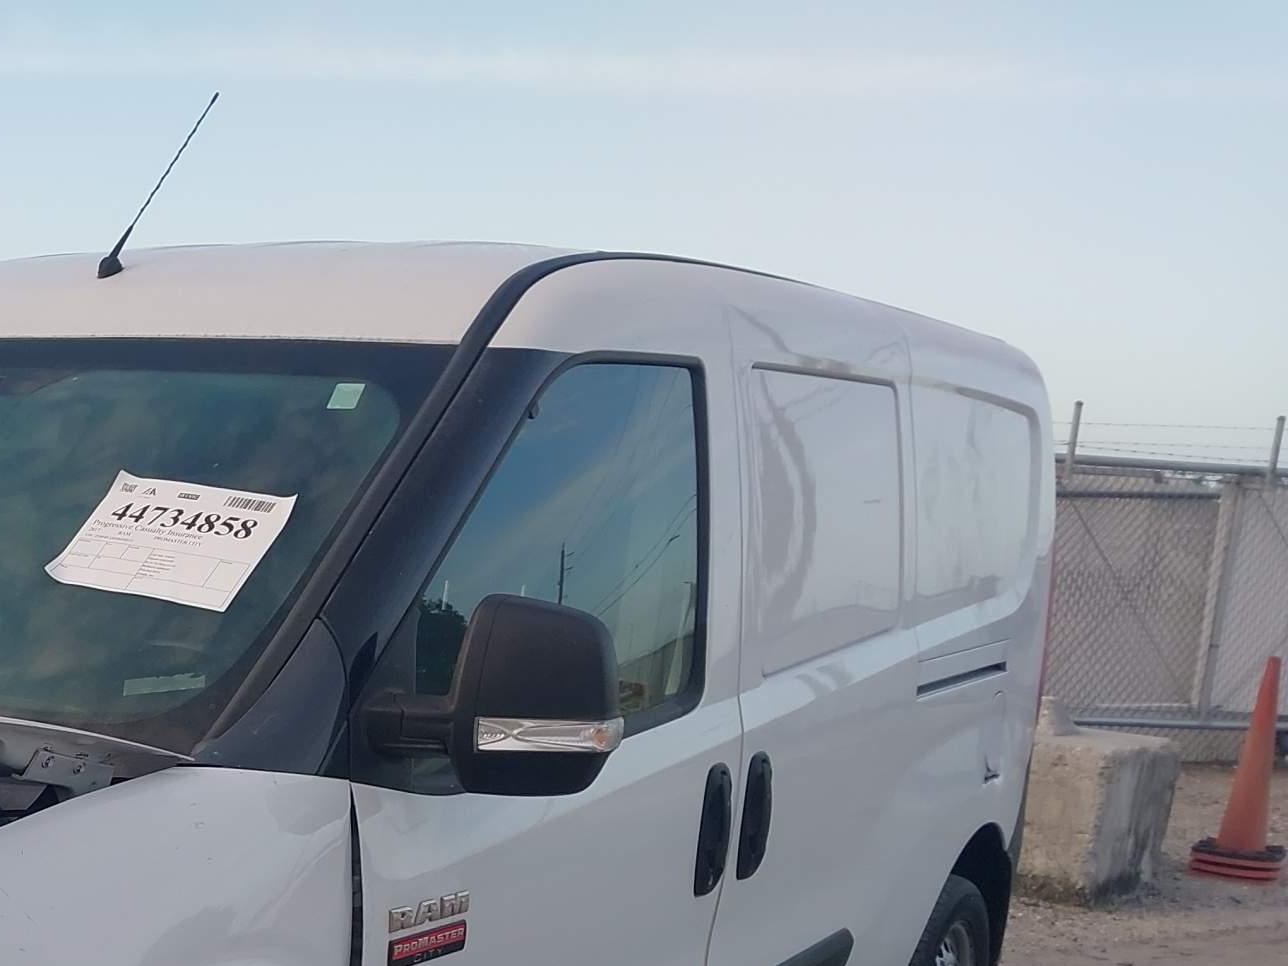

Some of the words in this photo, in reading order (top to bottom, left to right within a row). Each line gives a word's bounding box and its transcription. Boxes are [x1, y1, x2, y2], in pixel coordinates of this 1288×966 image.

[93, 519, 133, 530] Progressive
[135, 524, 167, 536] Casualty
[168, 529, 204, 540] Insurance
[111, 502, 258, 539] 44734858
[388, 890, 470, 933] RAM
